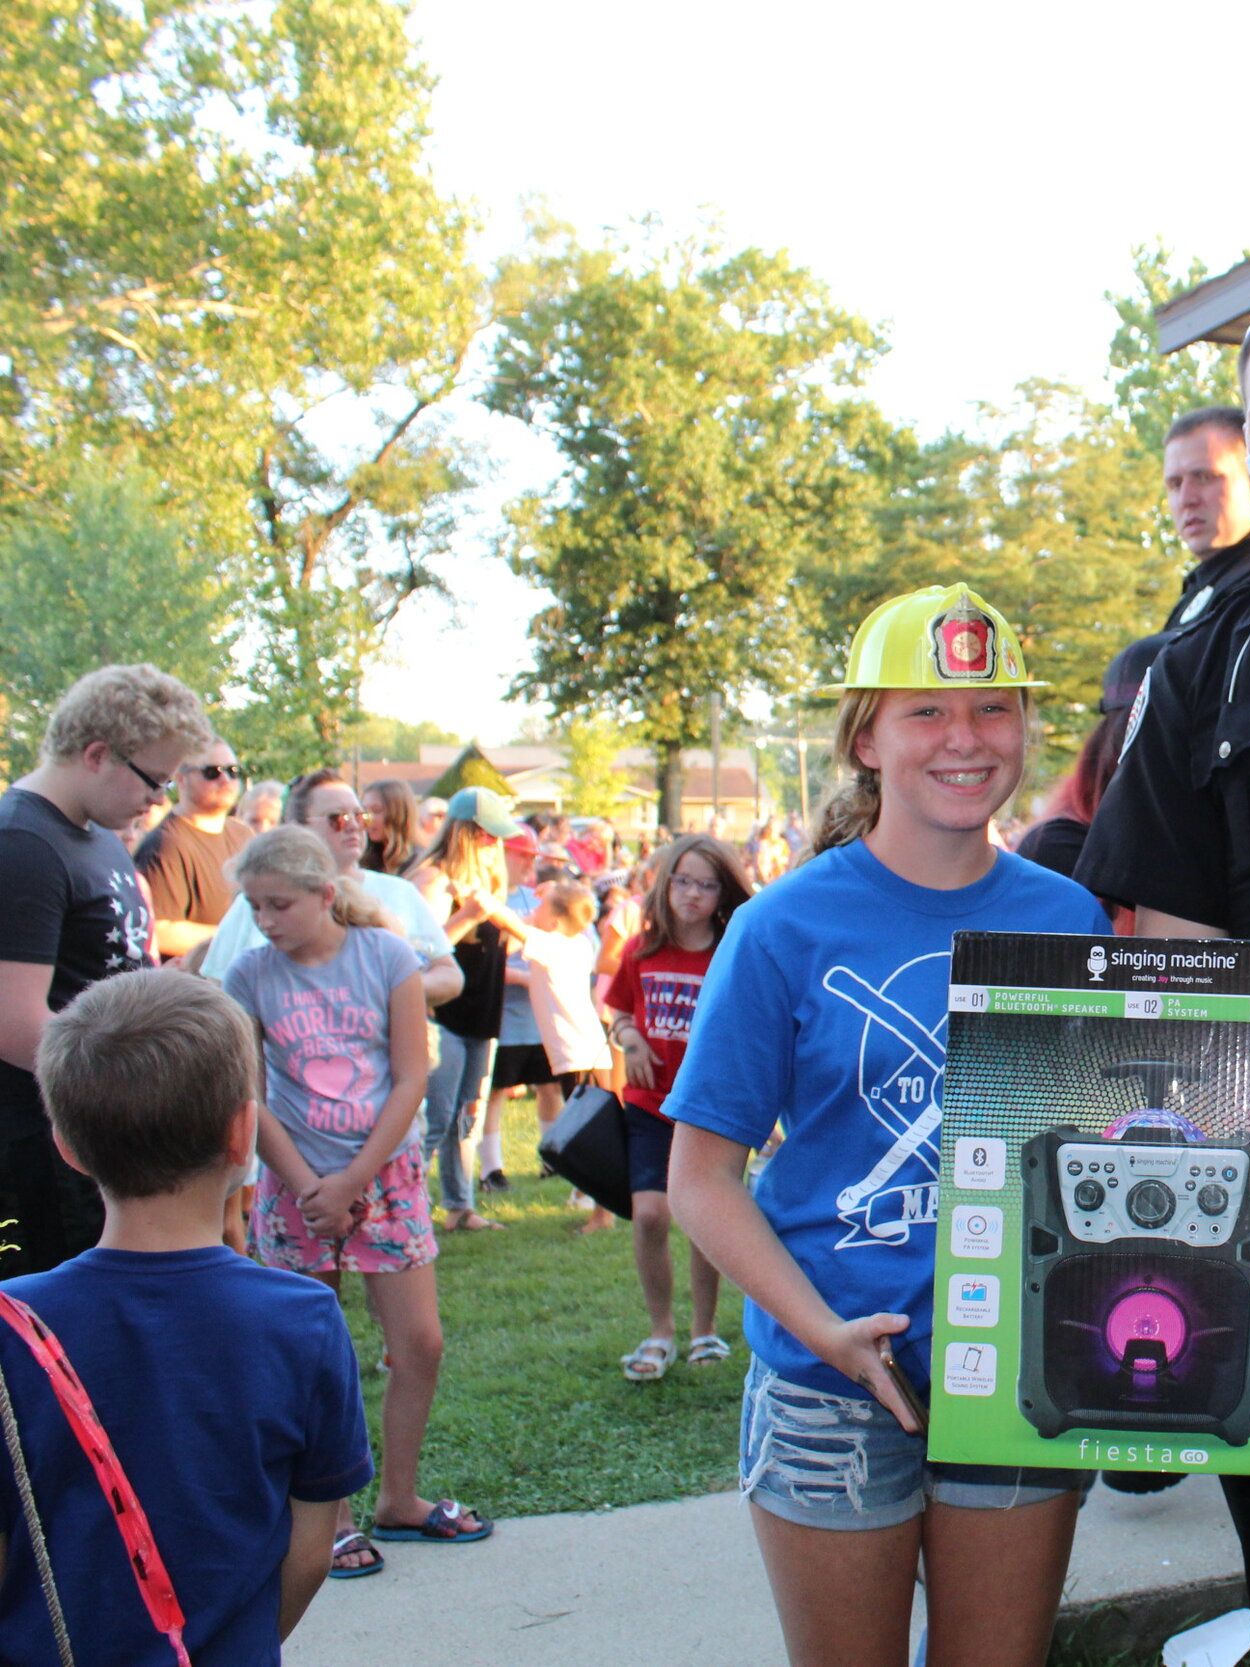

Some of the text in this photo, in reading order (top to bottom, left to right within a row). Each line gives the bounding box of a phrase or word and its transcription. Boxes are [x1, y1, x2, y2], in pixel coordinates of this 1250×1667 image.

[1111, 949, 1236, 971] singing machine
[1132, 974, 1156, 983] creating
[1170, 976, 1193, 984] through
[283, 986, 352, 1008] I HAVE THE
[971, 993, 984, 1007] 01
[994, 992, 1049, 1002] POWERFUL
[1167, 999, 1181, 1007] PA
[1061, 1004, 1108, 1014] SPEAKER
[1144, 999, 1157, 1014] 02
[1167, 1008, 1208, 1018] SYSTEM
[268, 1005, 378, 1048] WORLD'S
[303, 1035, 346, 1058] BEST
[898, 1076, 925, 1103] TO
[307, 1099, 376, 1132] MOM
[1079, 1438, 1204, 1463] fiesta GO
